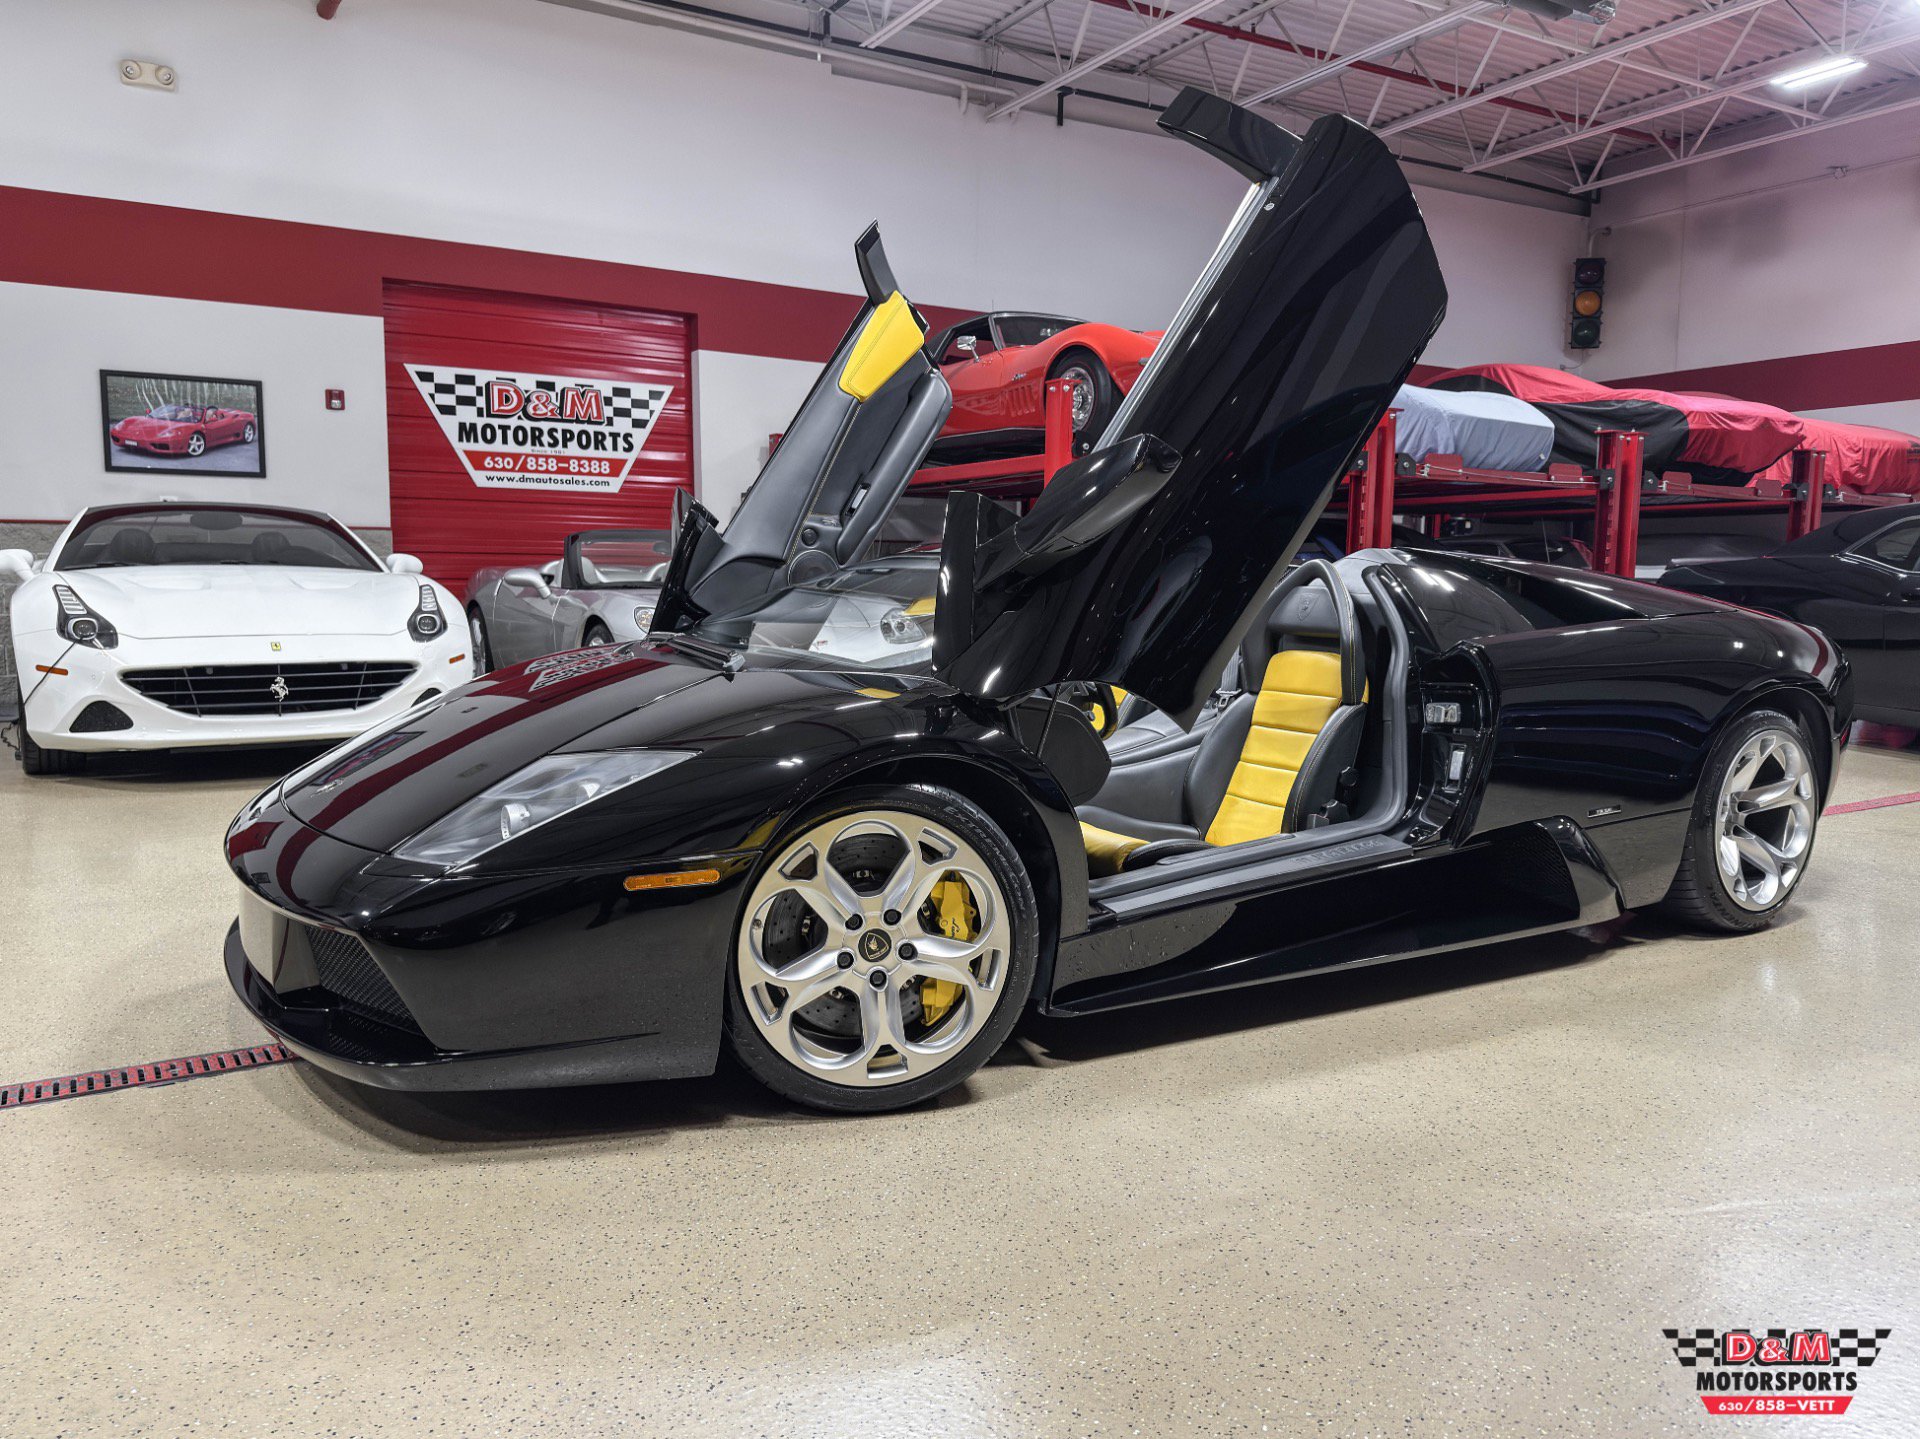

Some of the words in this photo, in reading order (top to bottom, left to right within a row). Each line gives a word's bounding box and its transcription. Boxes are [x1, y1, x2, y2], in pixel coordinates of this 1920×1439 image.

[485, 381, 606, 425] D&M
[458, 422, 634, 452] MOTORSPORTS
[484, 457, 610, 473] 630/858-8388
[485, 474, 610, 487] www.dmautosales.com
